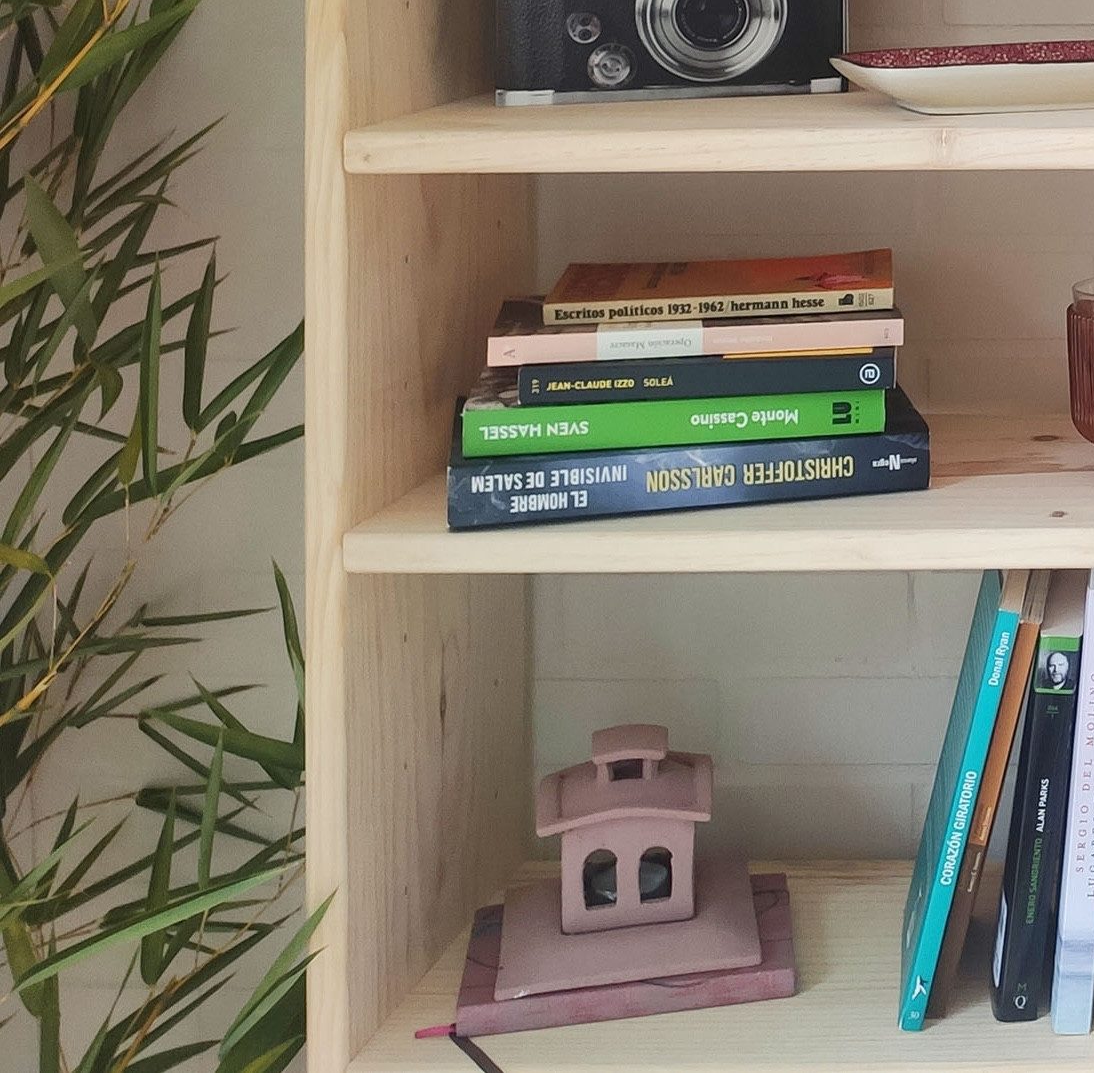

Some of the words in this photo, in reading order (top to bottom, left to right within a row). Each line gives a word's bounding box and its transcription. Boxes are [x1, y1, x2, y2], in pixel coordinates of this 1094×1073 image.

[554, 307, 605, 321] Escritos
[608, 304, 664, 320] políticos
[792, 297, 825, 309] hesse
[647, 337, 693, 352] Operación
[546, 379, 613, 392] JEAN-CLAUDE
[613, 378, 635, 389] IZZO
[643, 375, 674, 388] SOLEÁ
[546, 420, 590, 437] SVEN
[690, 411, 749, 429] Cassino
[751, 409, 799, 426] Monte
[478, 423, 542, 441] HASSEL
[525, 470, 545, 489] DE
[549, 464, 628, 488] INVISIBLE
[645, 464, 737, 493] CARLSSON
[743, 454, 856, 486] CHRISTOFFER
[471, 473, 524, 494] SALEM
[509, 491, 568, 514] HOMBRE
[569, 489, 588, 508] EL
[995, 631, 1010, 656] Ryan
[988, 657, 1004, 686] Donal
[1081, 758, 1093, 792] DEL
[1037, 777, 1050, 808] PARKS
[940, 831, 963, 886] CORAZÓN
[953, 770, 978, 830] GIRATORIO
[1035, 808, 1046, 833] ALAN
[1075, 804, 1089, 873] SERGIO
[1029, 837, 1043, 893] SANGRIENTO
[1025, 894, 1037, 925] ENERO
